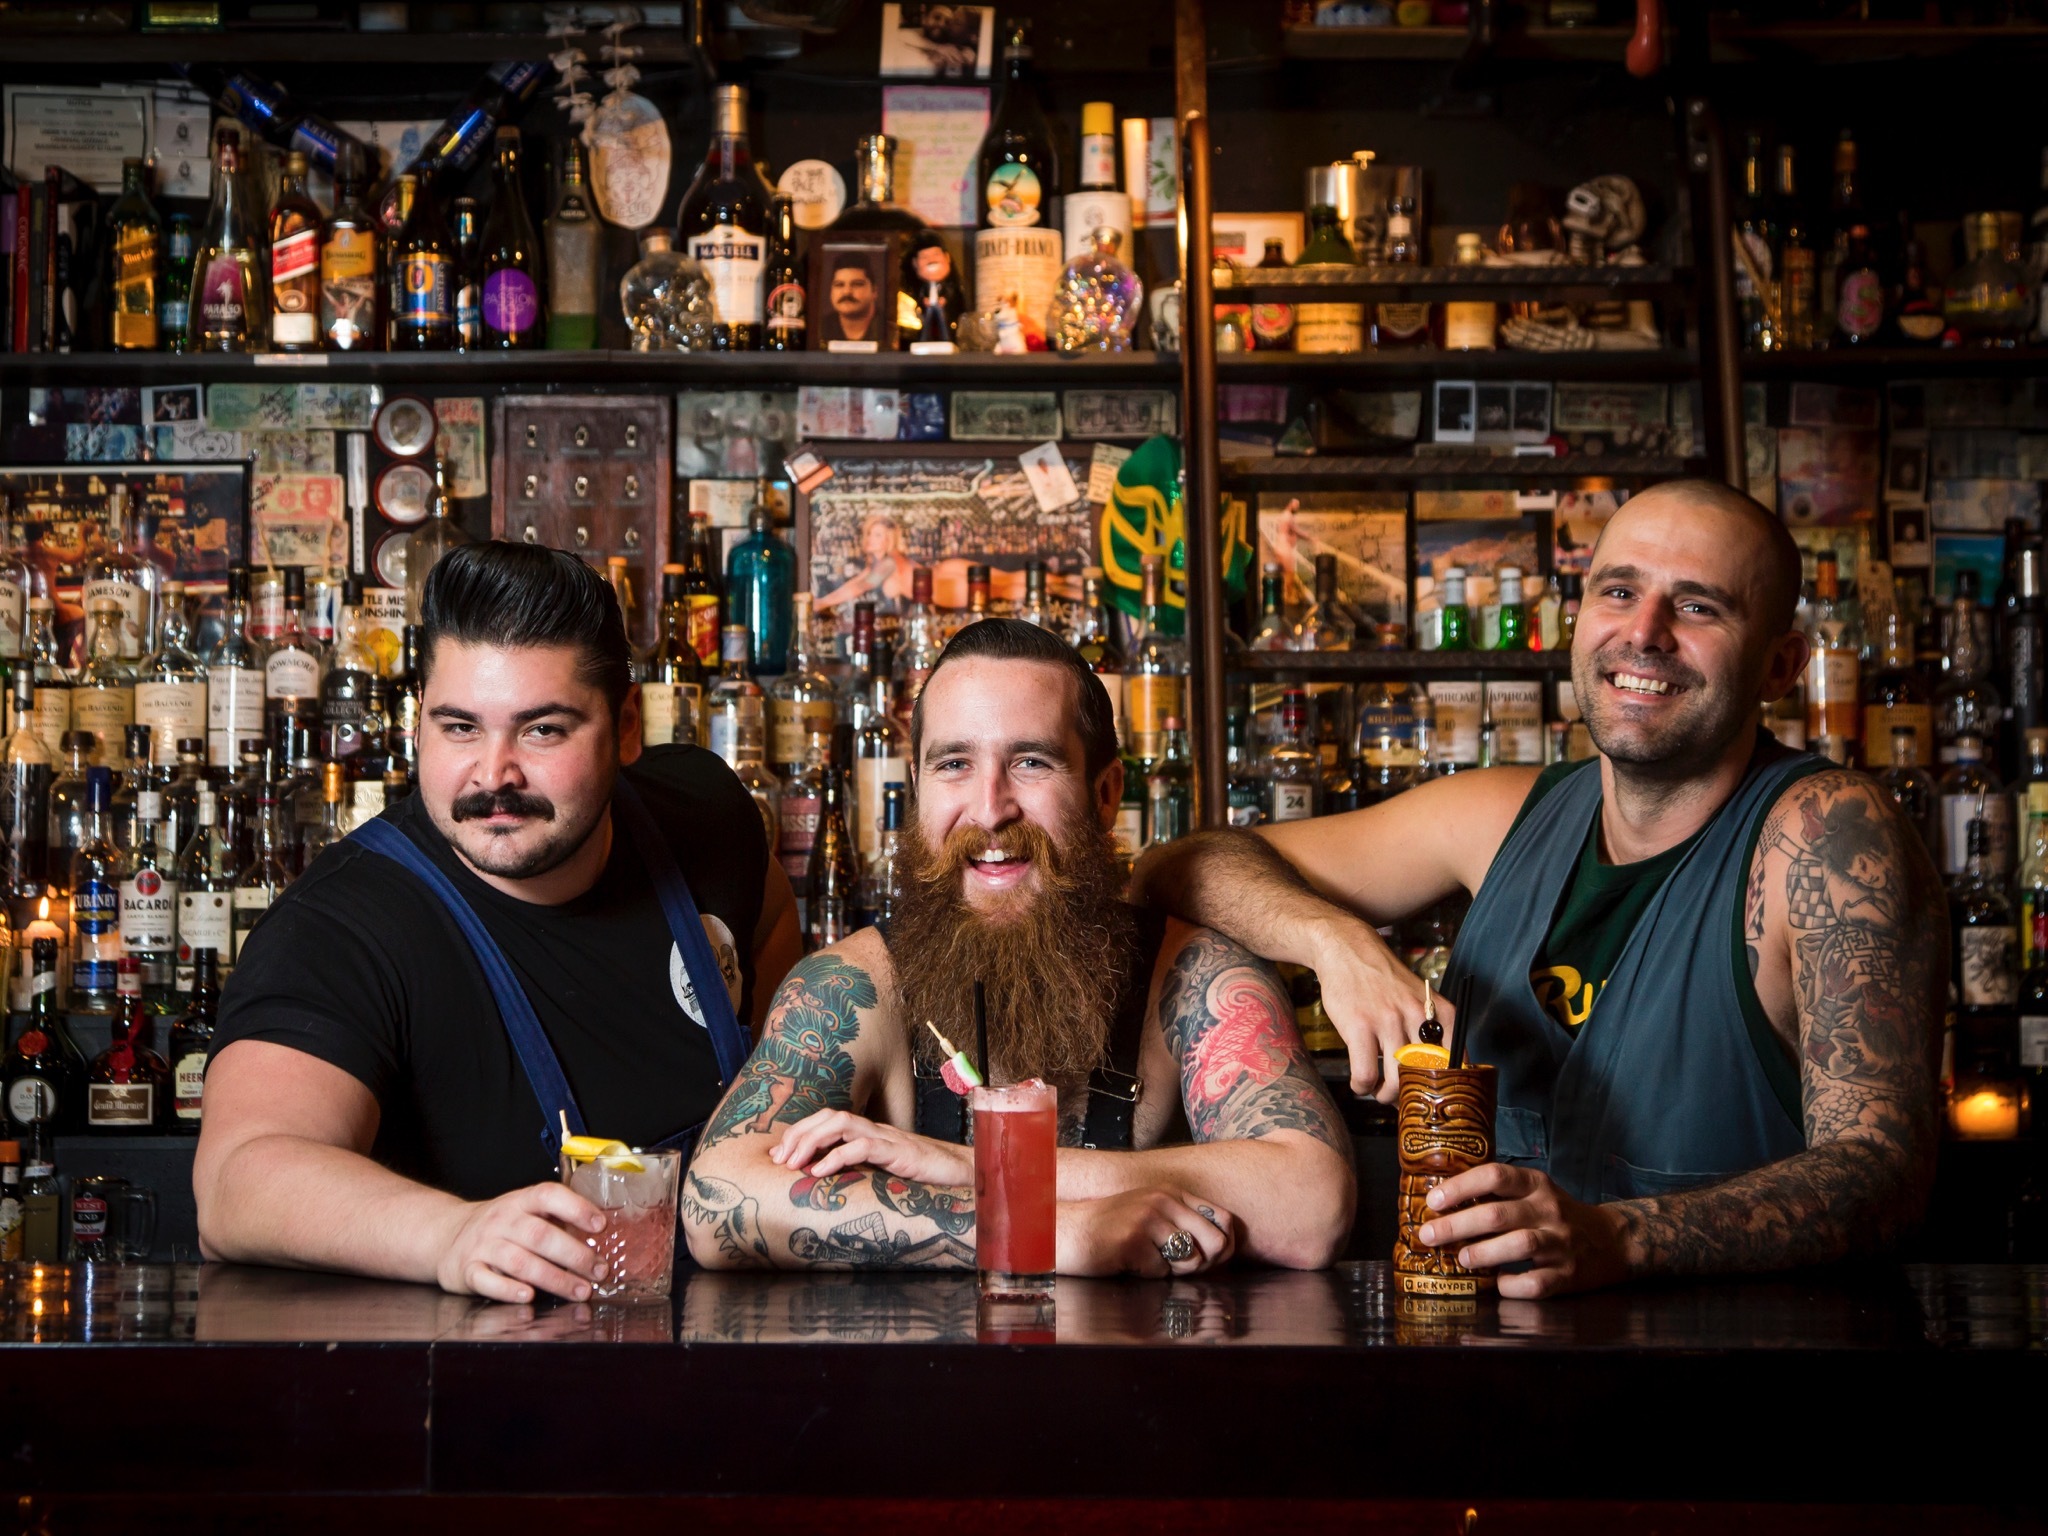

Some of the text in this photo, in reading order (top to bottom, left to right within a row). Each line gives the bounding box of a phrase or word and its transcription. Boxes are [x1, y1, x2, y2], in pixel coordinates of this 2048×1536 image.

[700, 245, 753, 257] MARTELL
[87, 585, 131, 599] JAMESON
[363, 594, 405, 606] TLE MIS
[268, 657, 316, 675] BOWMORE
[88, 704, 125, 712] BALVENIE
[154, 700, 193, 708] BALVENIE
[1286, 795, 1305, 809] 24
[74, 893, 117, 909] CUBANEY
[179, 1072, 203, 1083] HEER
[93, 1099, 145, 1111] Grand Marnier
[1417, 1281, 1474, 1291] DE KUYPER
